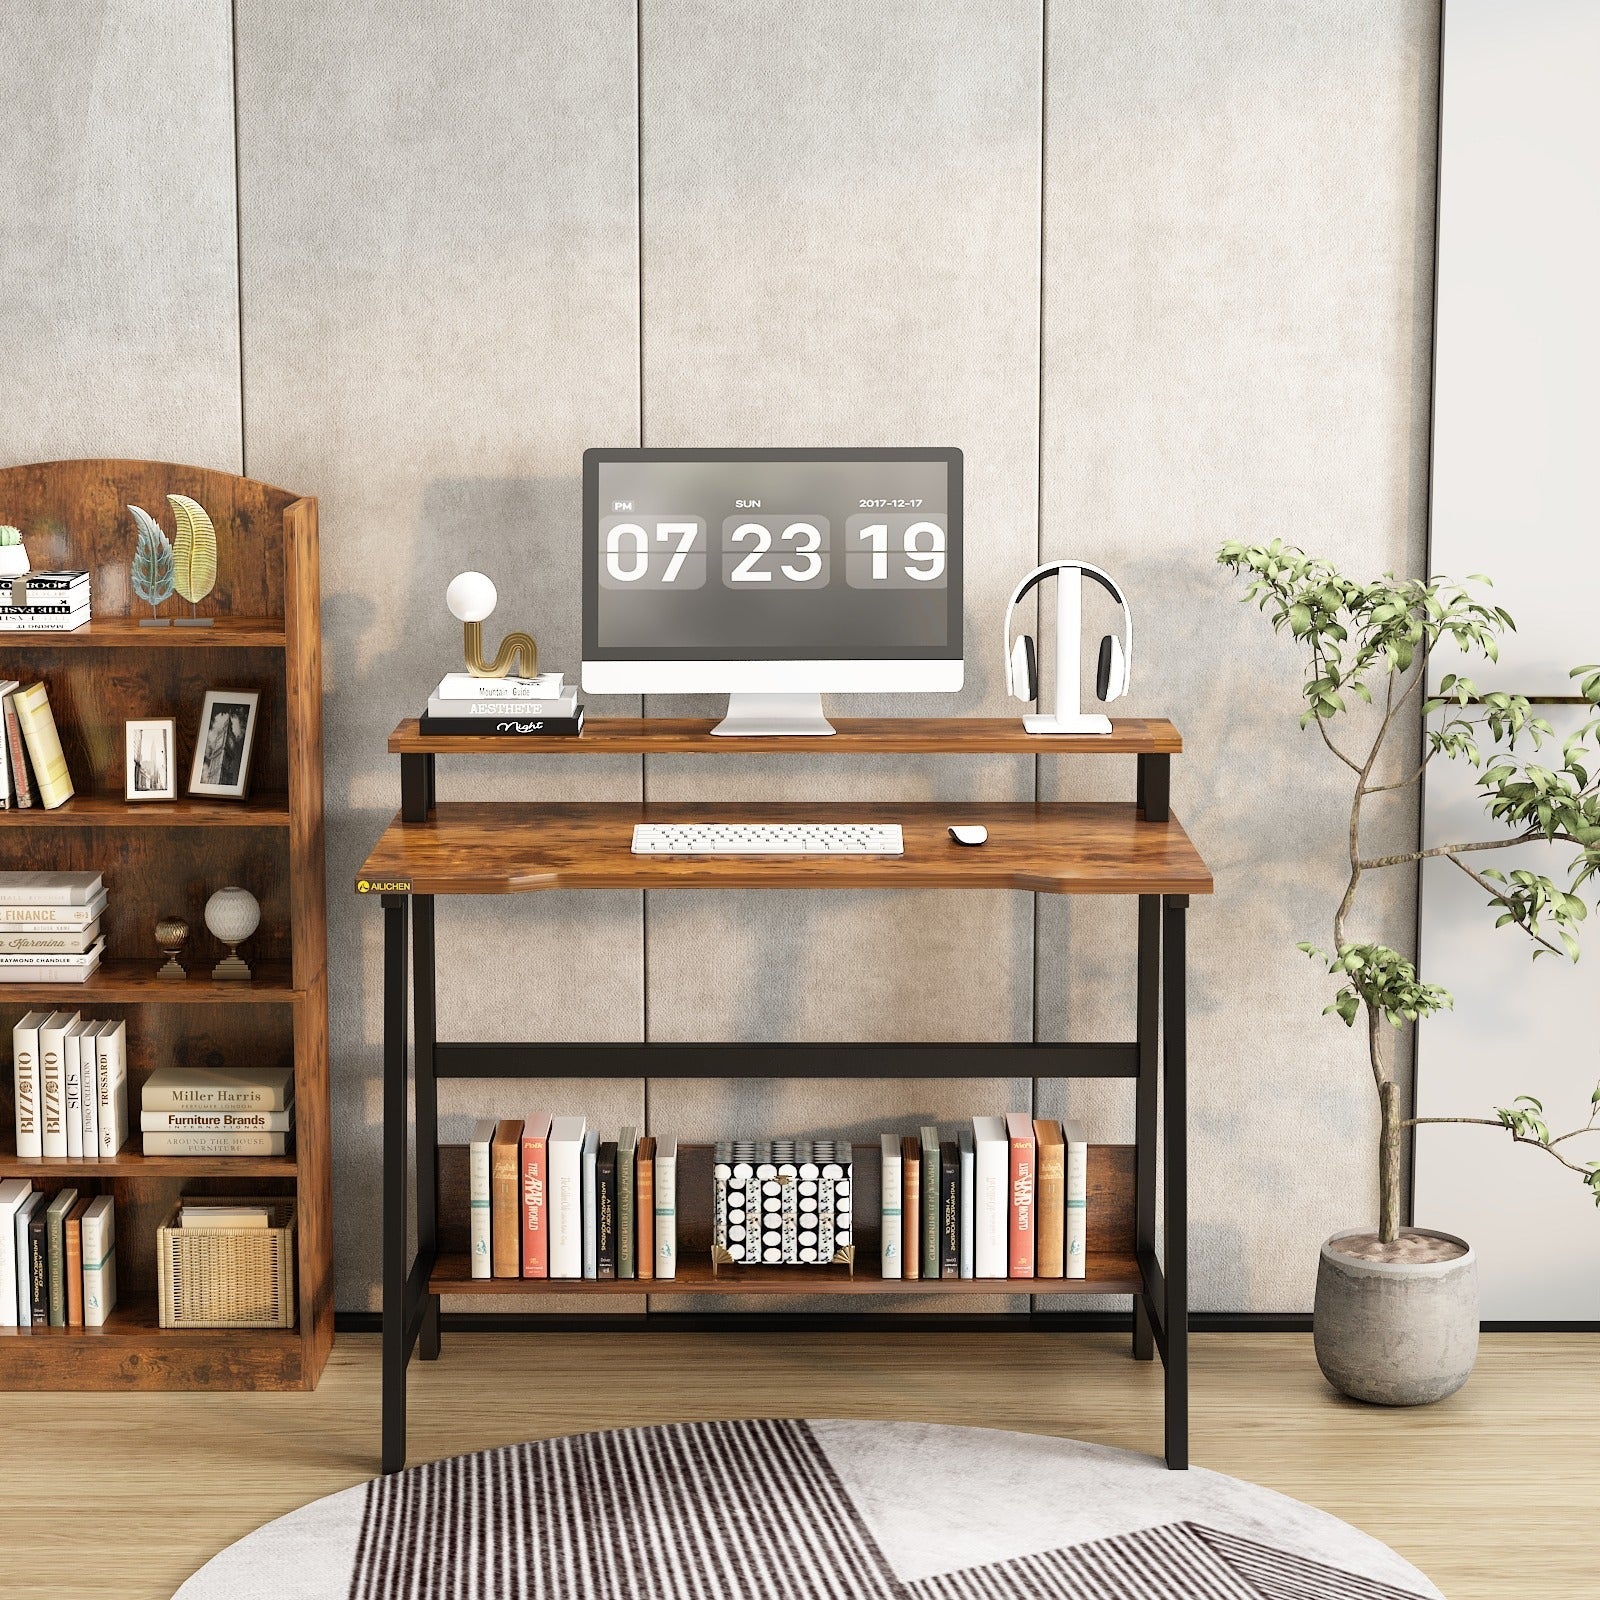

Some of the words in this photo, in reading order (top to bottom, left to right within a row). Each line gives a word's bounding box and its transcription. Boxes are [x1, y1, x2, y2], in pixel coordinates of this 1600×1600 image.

[614, 502, 632, 510] PM
[735, 500, 761, 508] SUN
[859, 499, 923, 508] 2017-12-17
[606, 523, 698, 582] 07
[731, 522, 822, 582] 23
[859, 521, 946, 582] 19
[479, 687, 508, 696] Mountain
[512, 687, 530, 696] Guide
[469, 703, 542, 714] AESTHETE
[496, 721, 544, 733] Night
[371, 882, 410, 891] AILICHEN
[6, 910, 56, 920] FINANCE
[8, 938, 65, 950] Karenina
[100, 1054, 108, 1106] TRUSSARDI
[67, 1074, 79, 1109] SICIS
[172, 1090, 214, 1101] Miller
[218, 1090, 261, 1101] Harris
[168, 1114, 221, 1125] Furniture
[224, 1114, 265, 1125] Brands
[528, 1162, 538, 1176] THE
[525, 1174, 543, 1206] ARAB
[528, 1206, 538, 1231] WORLD
